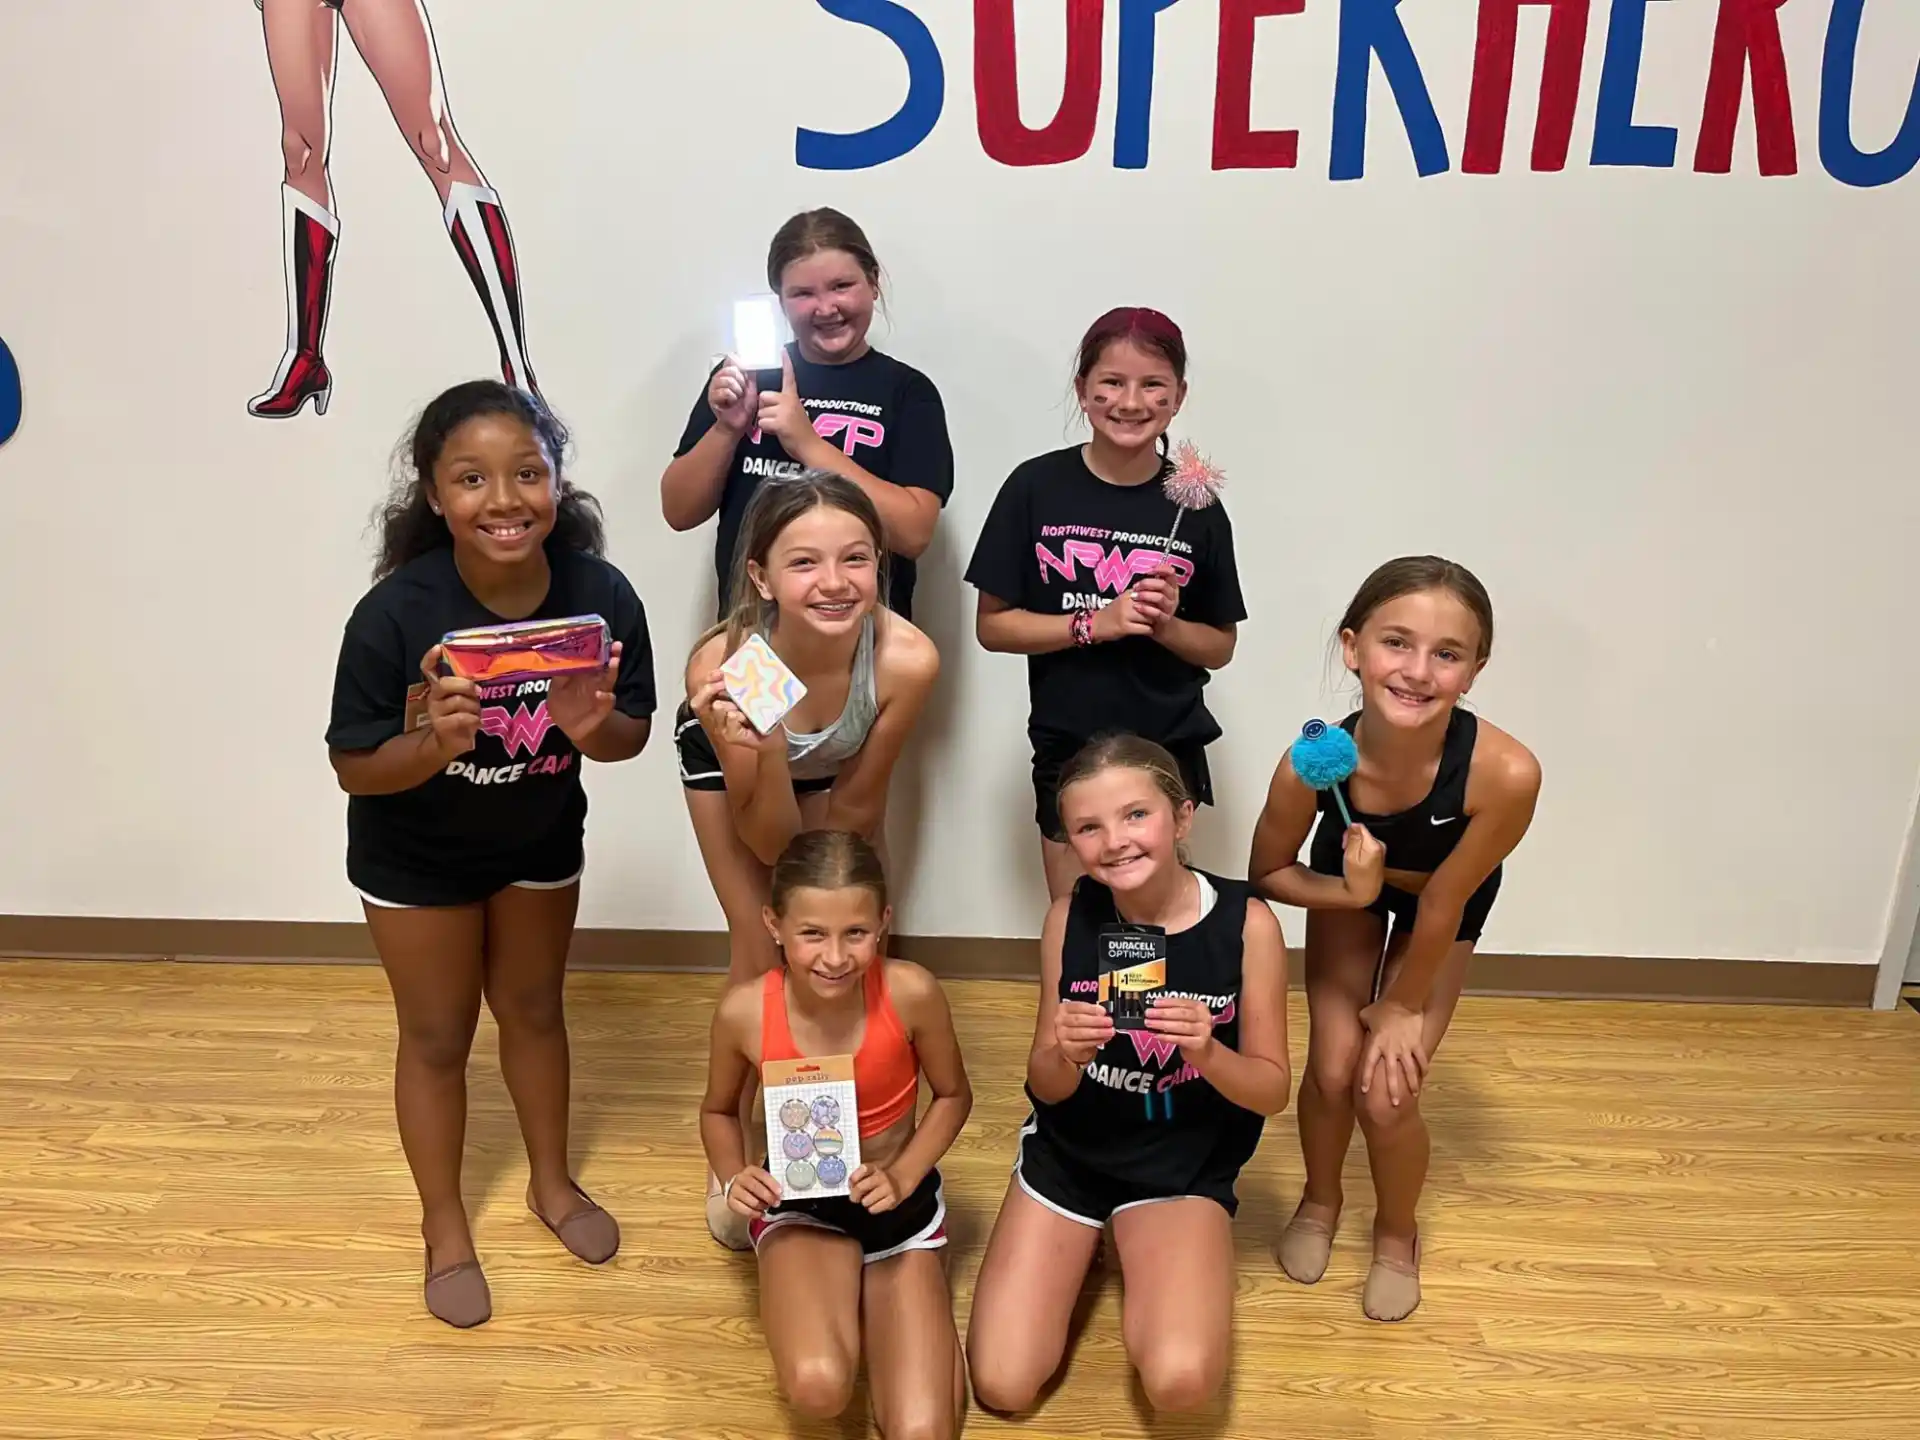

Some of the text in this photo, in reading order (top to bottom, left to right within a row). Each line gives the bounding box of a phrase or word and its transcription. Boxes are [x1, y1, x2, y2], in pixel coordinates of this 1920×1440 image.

[803, 399, 882, 417] PRODUCTIONS
[743, 456, 802, 477] DANCE
[1041, 525, 1193, 554] NORTHWEST PRODUCTONS
[1062, 592, 1113, 610] DAN
[445, 753, 573, 785] DANCE CAM
[1108, 941, 1156, 951] DURACELL
[1108, 950, 1156, 959] OPTIMUM
[1087, 1061, 1201, 1094] DANCE CAM
